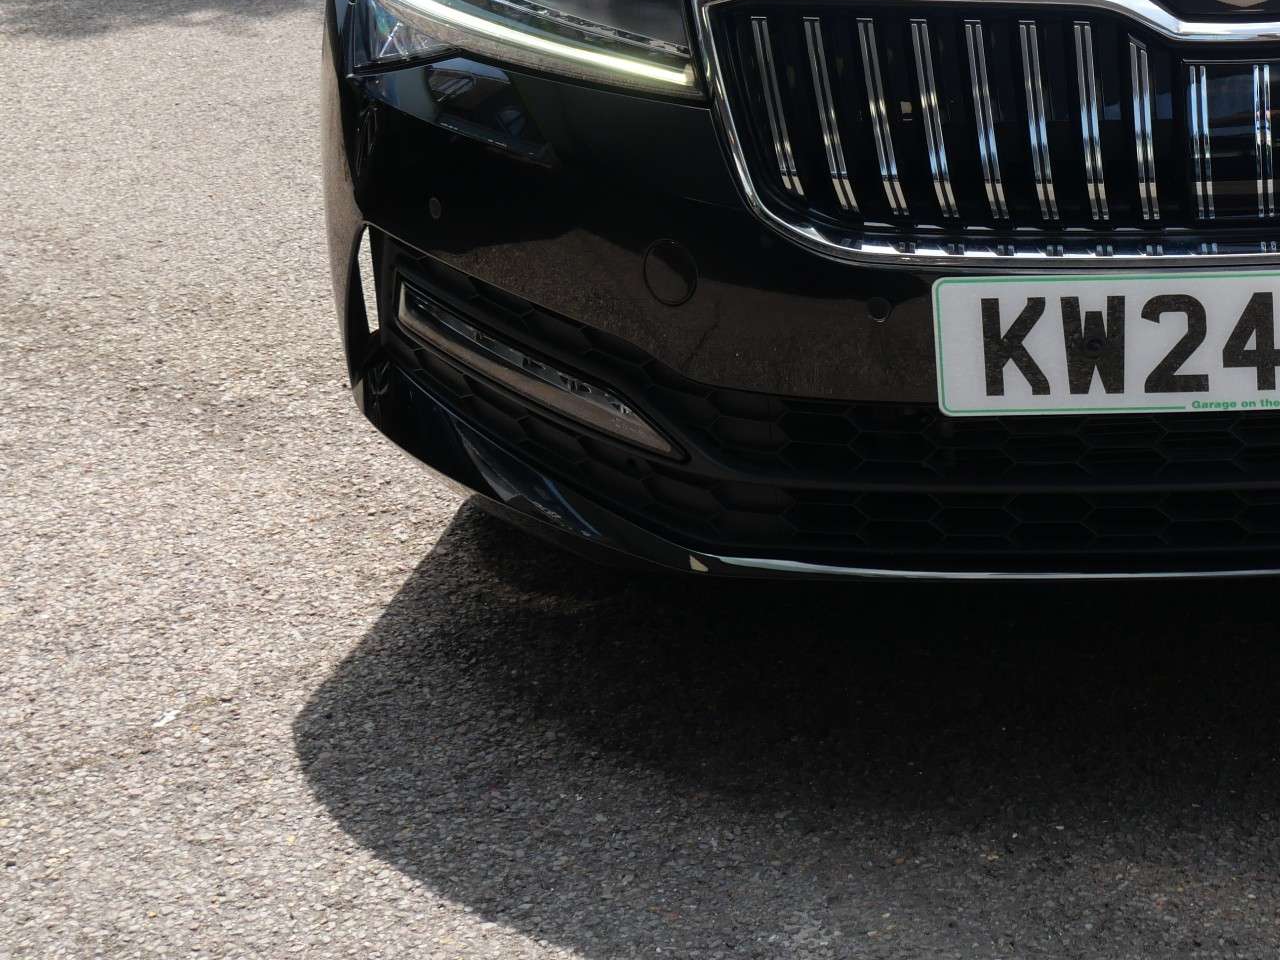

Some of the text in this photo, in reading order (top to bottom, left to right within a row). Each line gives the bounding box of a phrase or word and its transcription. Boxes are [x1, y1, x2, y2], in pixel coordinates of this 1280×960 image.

[1191, 400, 1237, 410] Garage
[1240, 400, 1256, 408] on
[1259, 398, 1280, 408] the
